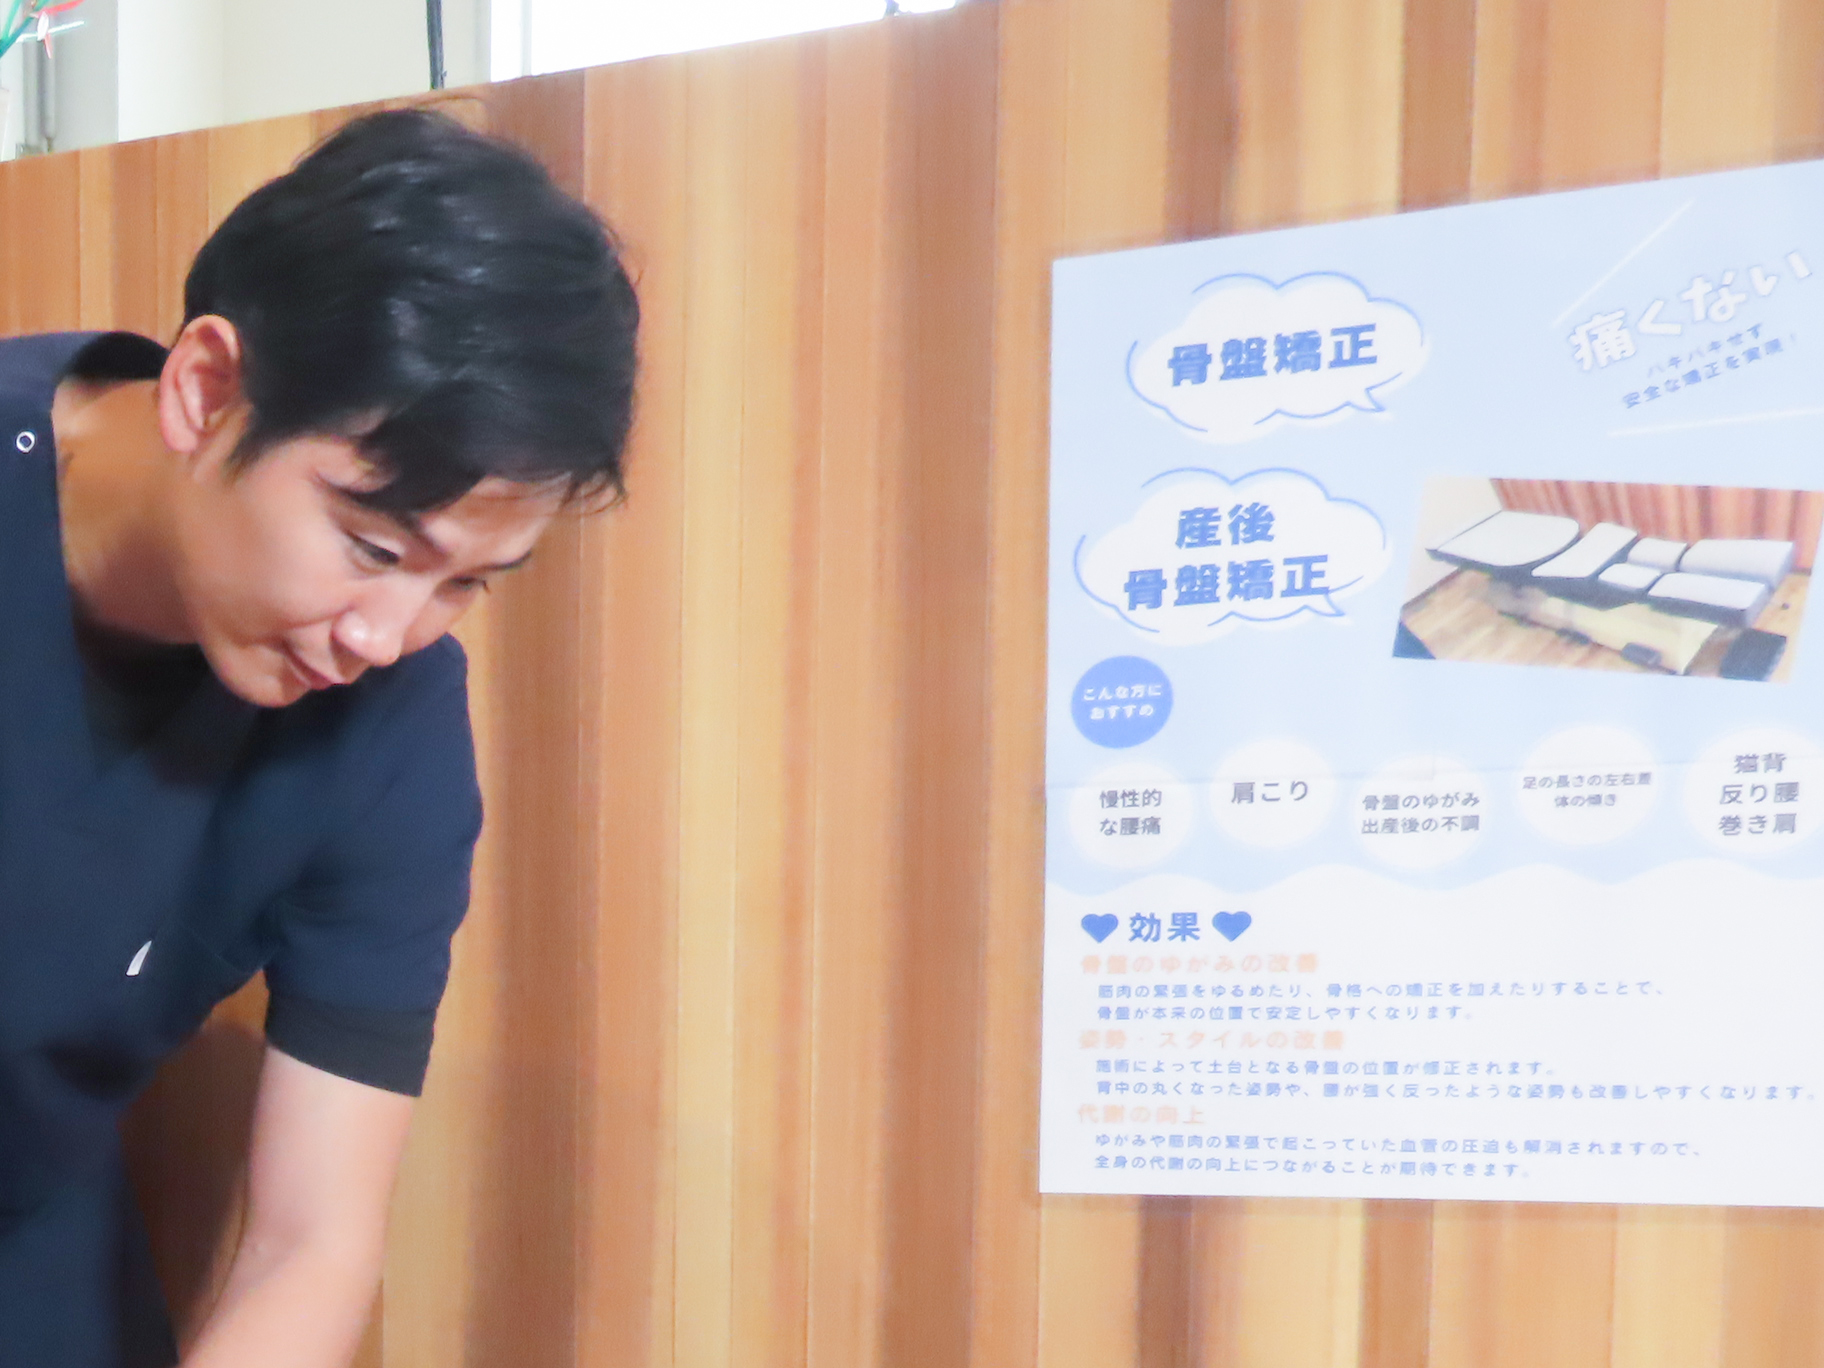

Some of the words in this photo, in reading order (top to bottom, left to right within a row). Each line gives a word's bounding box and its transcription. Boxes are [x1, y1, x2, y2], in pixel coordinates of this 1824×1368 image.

[1566, 250, 1813, 371] 痛くない
[1167, 323, 1378, 388] 骨盤矯正
[1175, 501, 1276, 549] 産後
[1122, 553, 1330, 610] 骨盤矯正
[1083, 683, 1162, 702] こんな方に
[1090, 704, 1155, 721] おすすめ
[1734, 752, 1787, 774] 猫背
[1099, 788, 1163, 809] 慢性的
[1231, 780, 1310, 804] 肩こり
[1362, 792, 1480, 812] 骨盤のゆがみ
[1719, 781, 1800, 805] 反り腰
[1099, 816, 1162, 836] な腰痛
[1361, 815, 1480, 835] 出産後の不調
[1718, 813, 1798, 836] 巻き肩
[1128, 911, 1201, 943] 効果
[1080, 952, 1320, 975] 骨盤のゆがみの改善
[1077, 1103, 1206, 1125] 代謝の向上
